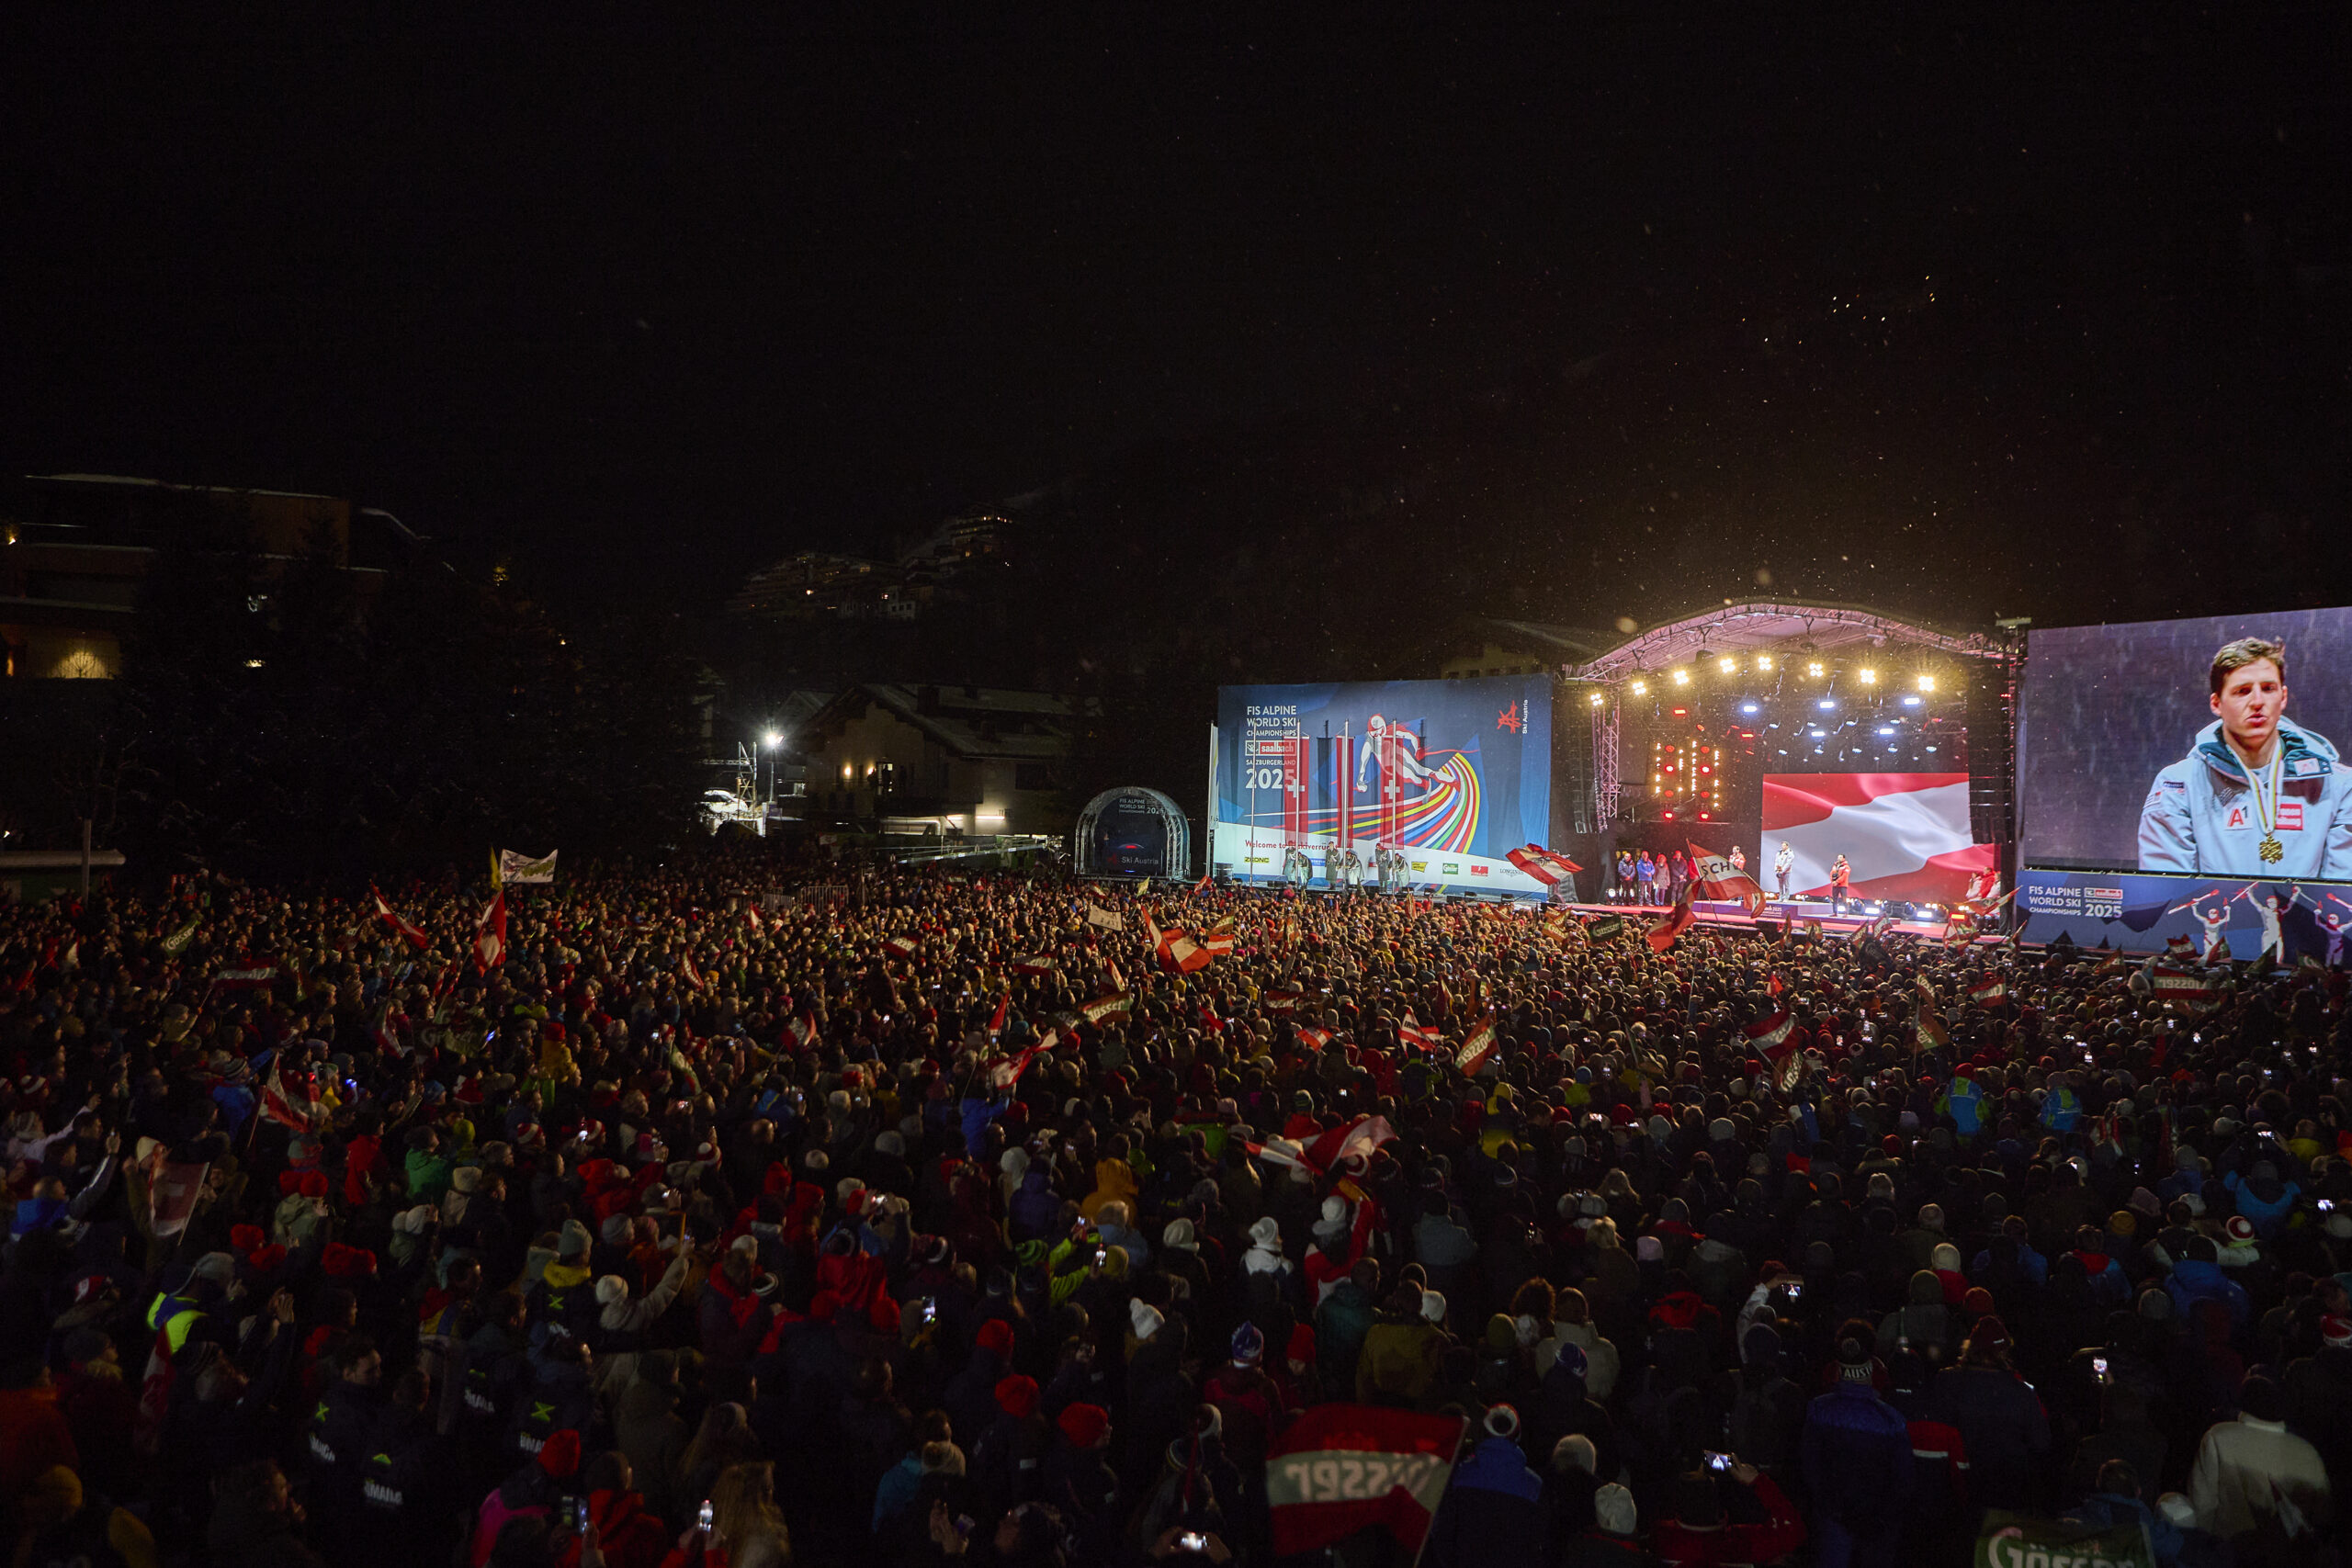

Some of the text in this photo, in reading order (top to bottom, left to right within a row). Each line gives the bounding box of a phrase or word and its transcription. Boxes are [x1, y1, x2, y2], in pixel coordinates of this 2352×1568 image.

[1247, 705, 1297, 716] FIS ALPINE
[1247, 717, 1296, 727] WORLD SKI
[1261, 741, 1294, 752] saalbach
[1245, 768, 1295, 790] 2025
[2227, 806, 2249, 828] A1
[1245, 840, 1277, 849] Welcome
[1134, 856, 1159, 865] Austria
[2029, 886, 2082, 897] FIS ALPINE
[2029, 897, 2064, 907] WORLD
[2065, 898, 2082, 907] SKI
[2029, 907, 2082, 916] CHAMPIONSHIPS
[2085, 904, 2123, 919] 2025
